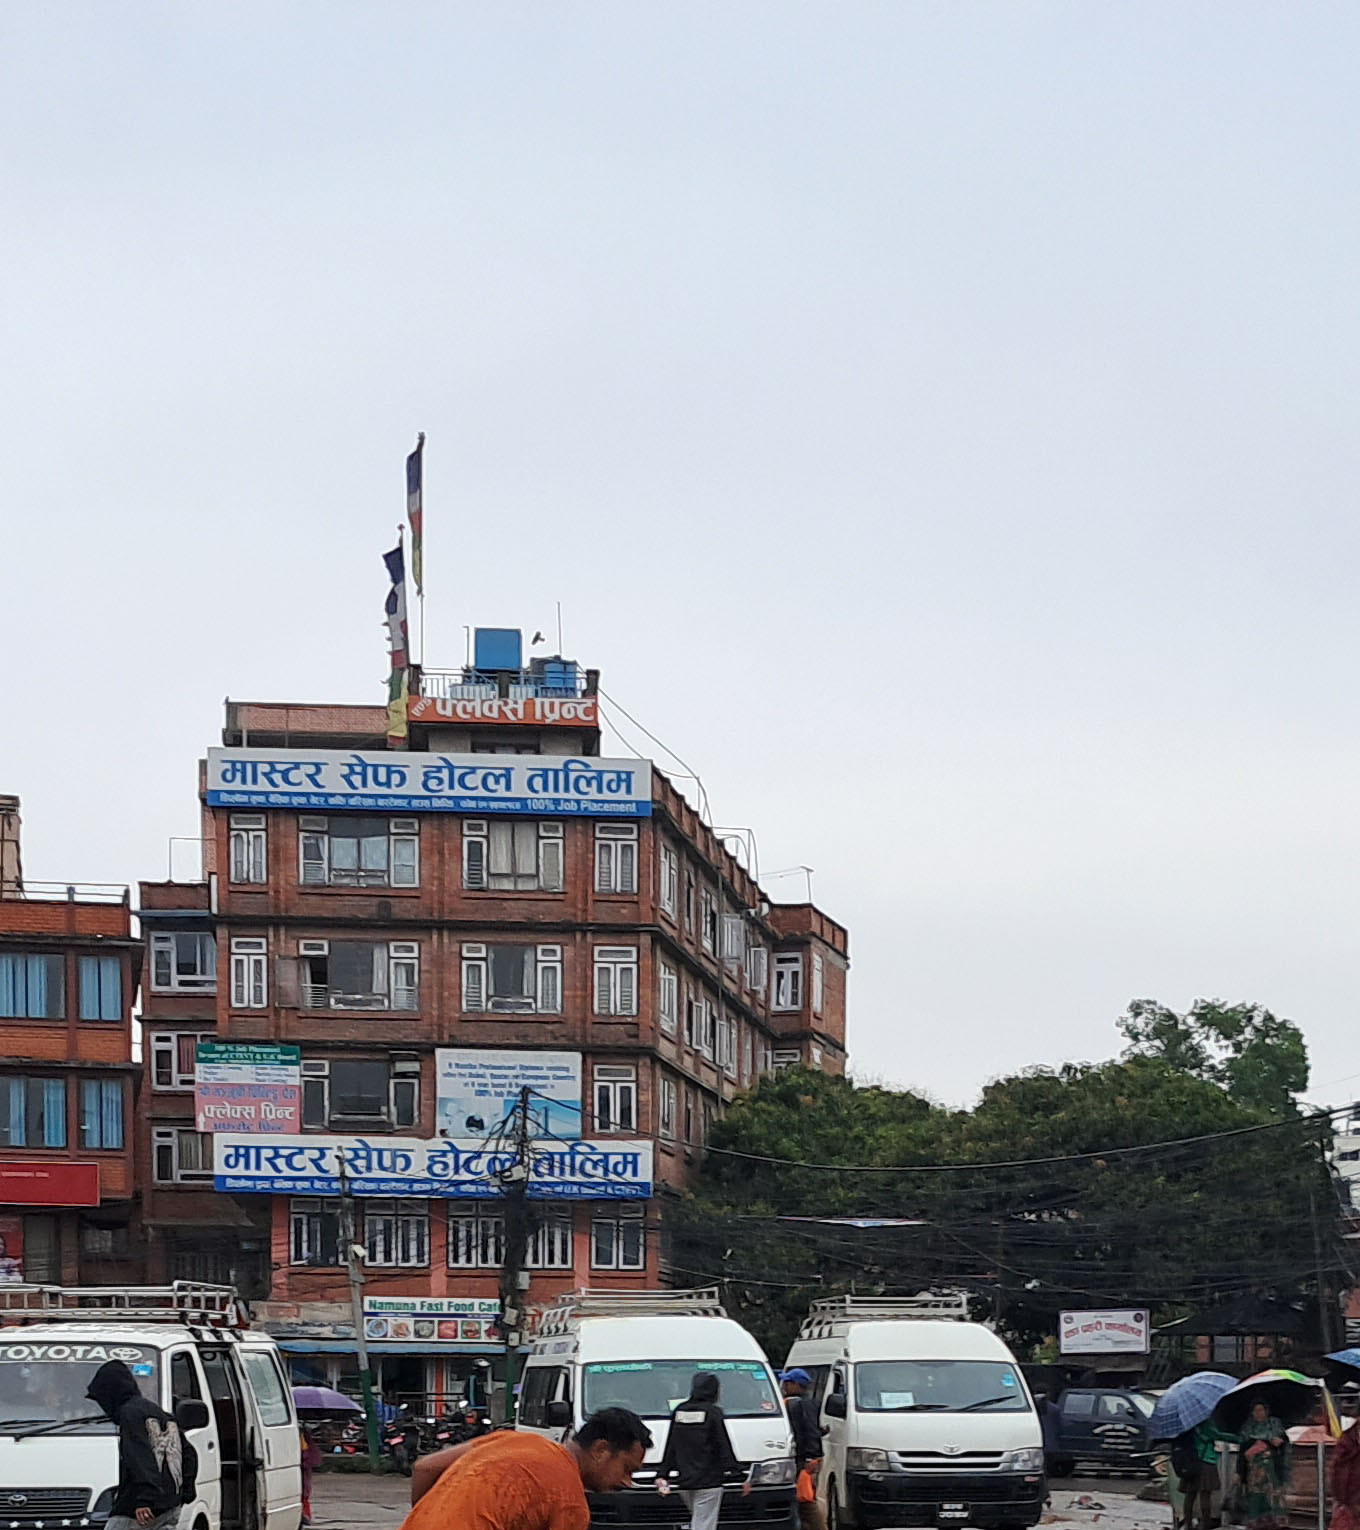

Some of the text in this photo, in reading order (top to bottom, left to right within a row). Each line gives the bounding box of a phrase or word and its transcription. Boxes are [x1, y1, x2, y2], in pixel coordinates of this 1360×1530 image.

[220, 754, 637, 796] मास्टर सेफ होटल तालिम
[557, 800, 578, 811] Job
[223, 1138, 642, 1179] मास्टर सेफ होटल तालिम
[420, 1300, 444, 1312] Fast
[447, 1301, 476, 1313] Food
